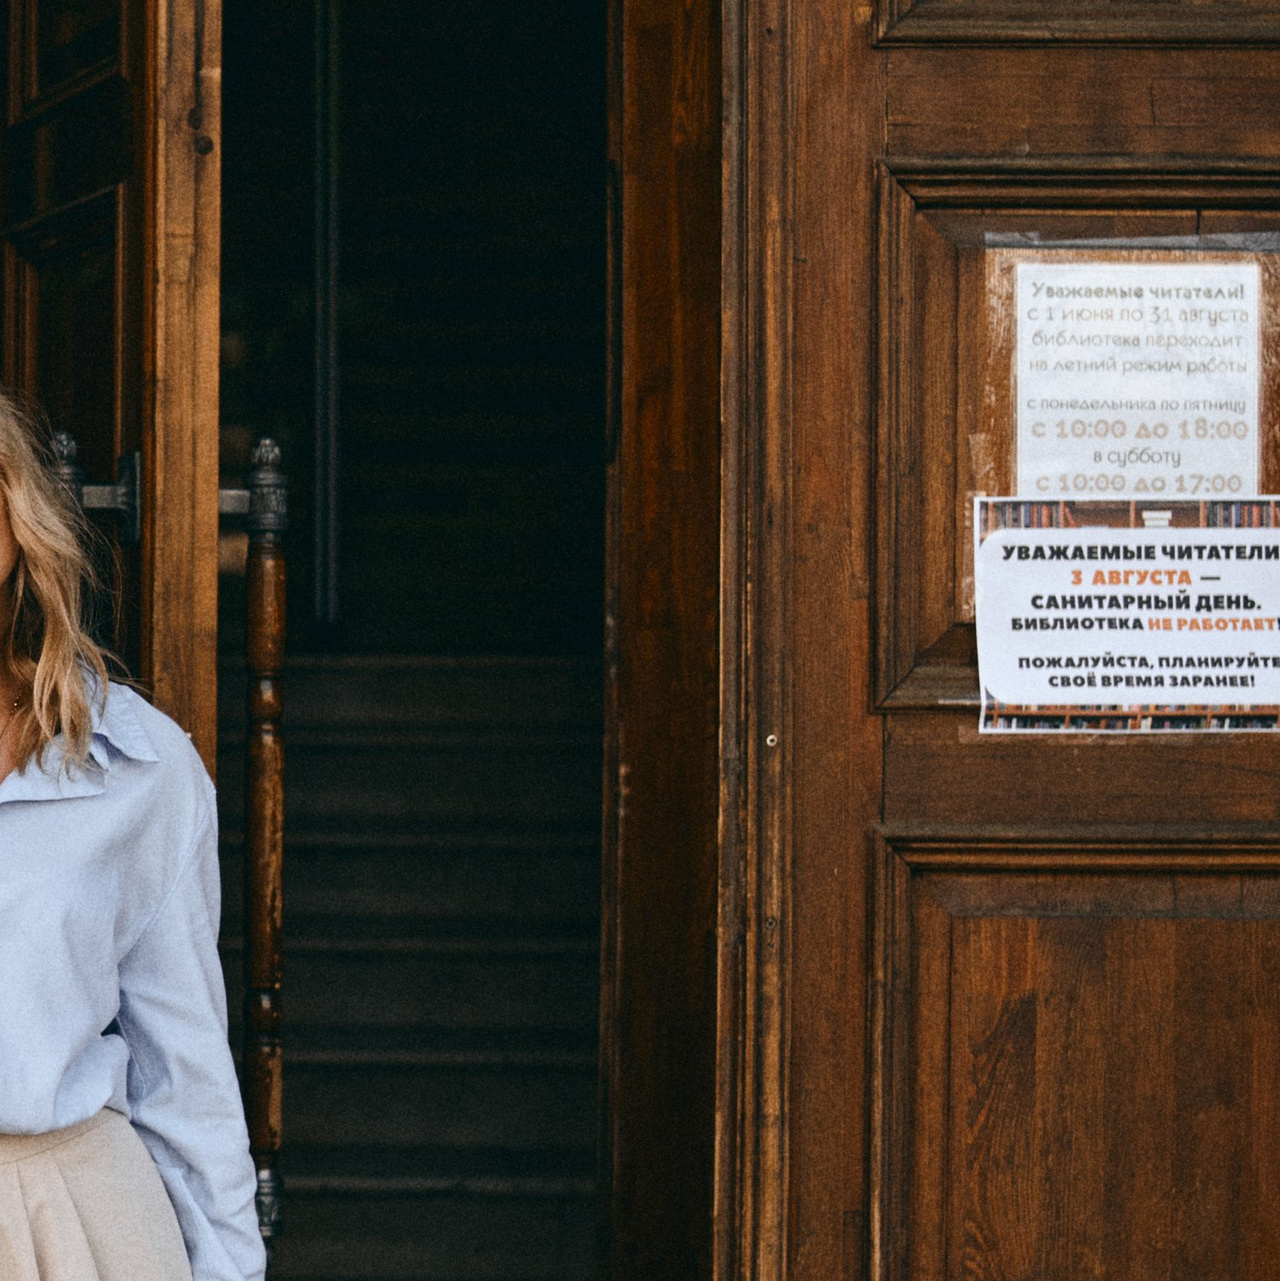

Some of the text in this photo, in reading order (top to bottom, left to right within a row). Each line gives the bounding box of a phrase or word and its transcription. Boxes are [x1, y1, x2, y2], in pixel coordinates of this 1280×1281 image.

[1031, 281, 1245, 300] Уважаемые читатели!
[1045, 306, 1054, 321] 1
[1061, 308, 1115, 322] июня
[1120, 308, 1144, 322] по
[1149, 306, 1173, 325] 31
[1179, 308, 1250, 328] августа
[1032, 329, 1244, 352] библиотека переходит
[1029, 356, 1248, 377] на летний режим работы
[1040, 399, 1157, 411] понедельника
[1161, 400, 1180, 411] по
[1184, 400, 1247, 415] пятницу
[1055, 419, 1128, 440] 10:00
[1134, 422, 1169, 440] до
[1178, 417, 1250, 441] 18:00
[1107, 447, 1182, 469] субботу
[1059, 473, 1127, 494] 10:00
[1133, 477, 1167, 493] до
[1175, 474, 1243, 496] 17:00
[1002, 545, 1280, 561] УВАЖАЕМЫЕ ЧИТАТЕЛИ
[1070, 570, 1083, 586] 3
[1092, 570, 1193, 586] АВГУСТА
[1031, 590, 1262, 613] САНИТАРНЫЙ ДЕНЬ.
[1011, 618, 1145, 631] БИБЛИОТЕКА
[1148, 618, 1173, 631] НЕ
[1018, 652, 1280, 670] ПОЖАЛУЙСТА, ПЛАНИРУЙТЕ
[1048, 673, 1256, 688] СВОЁ ВРЕМЯ ЗАРАНЕЕ!
